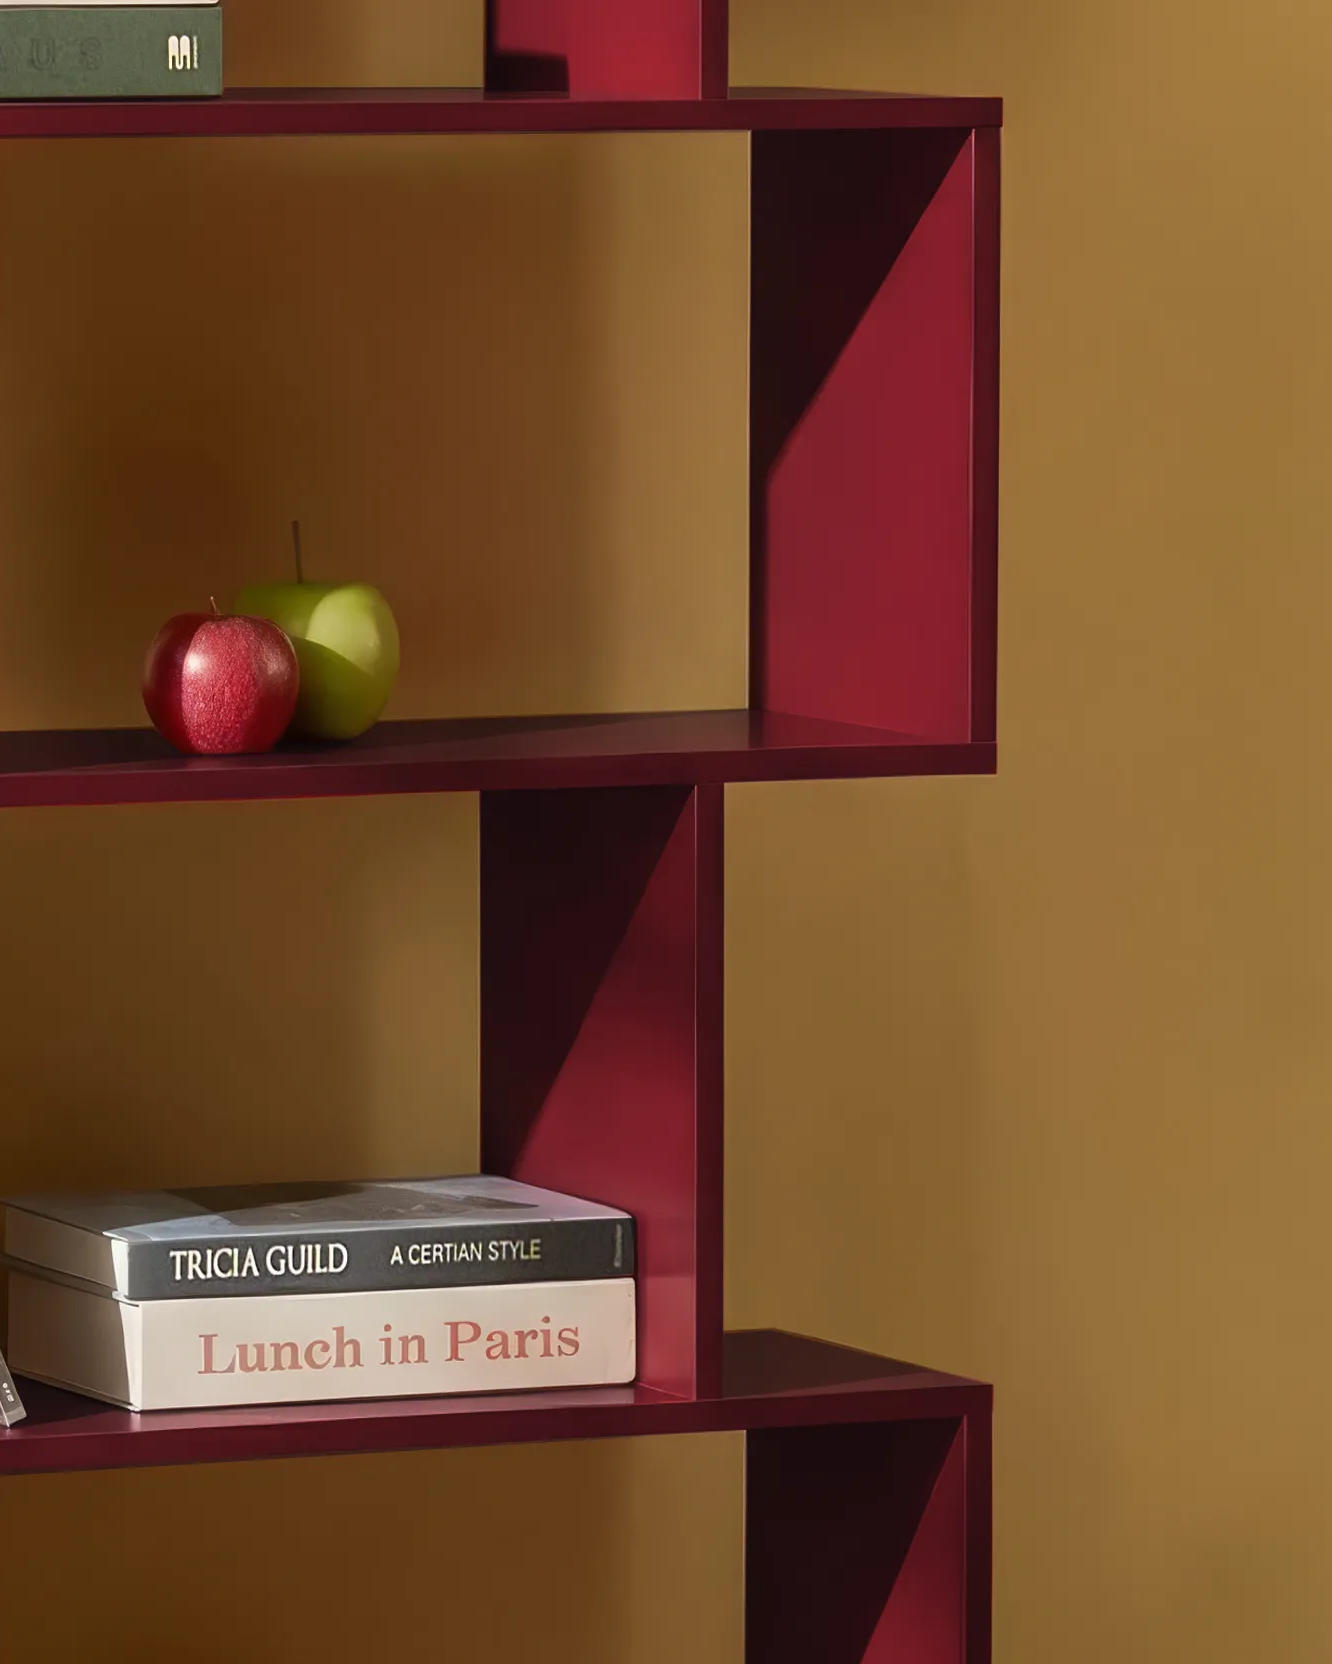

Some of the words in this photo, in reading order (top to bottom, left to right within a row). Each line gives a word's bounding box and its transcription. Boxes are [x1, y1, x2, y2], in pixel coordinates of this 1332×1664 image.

[169, 1245, 260, 1281] TRICIA
[266, 1242, 349, 1276] GUILD
[390, 1245, 404, 1265] A
[408, 1242, 483, 1265] CERTIAN
[487, 1238, 542, 1262] STYLE
[197, 1325, 365, 1374] Lunch
[379, 1323, 429, 1366] in
[443, 1316, 581, 1362] Paris
